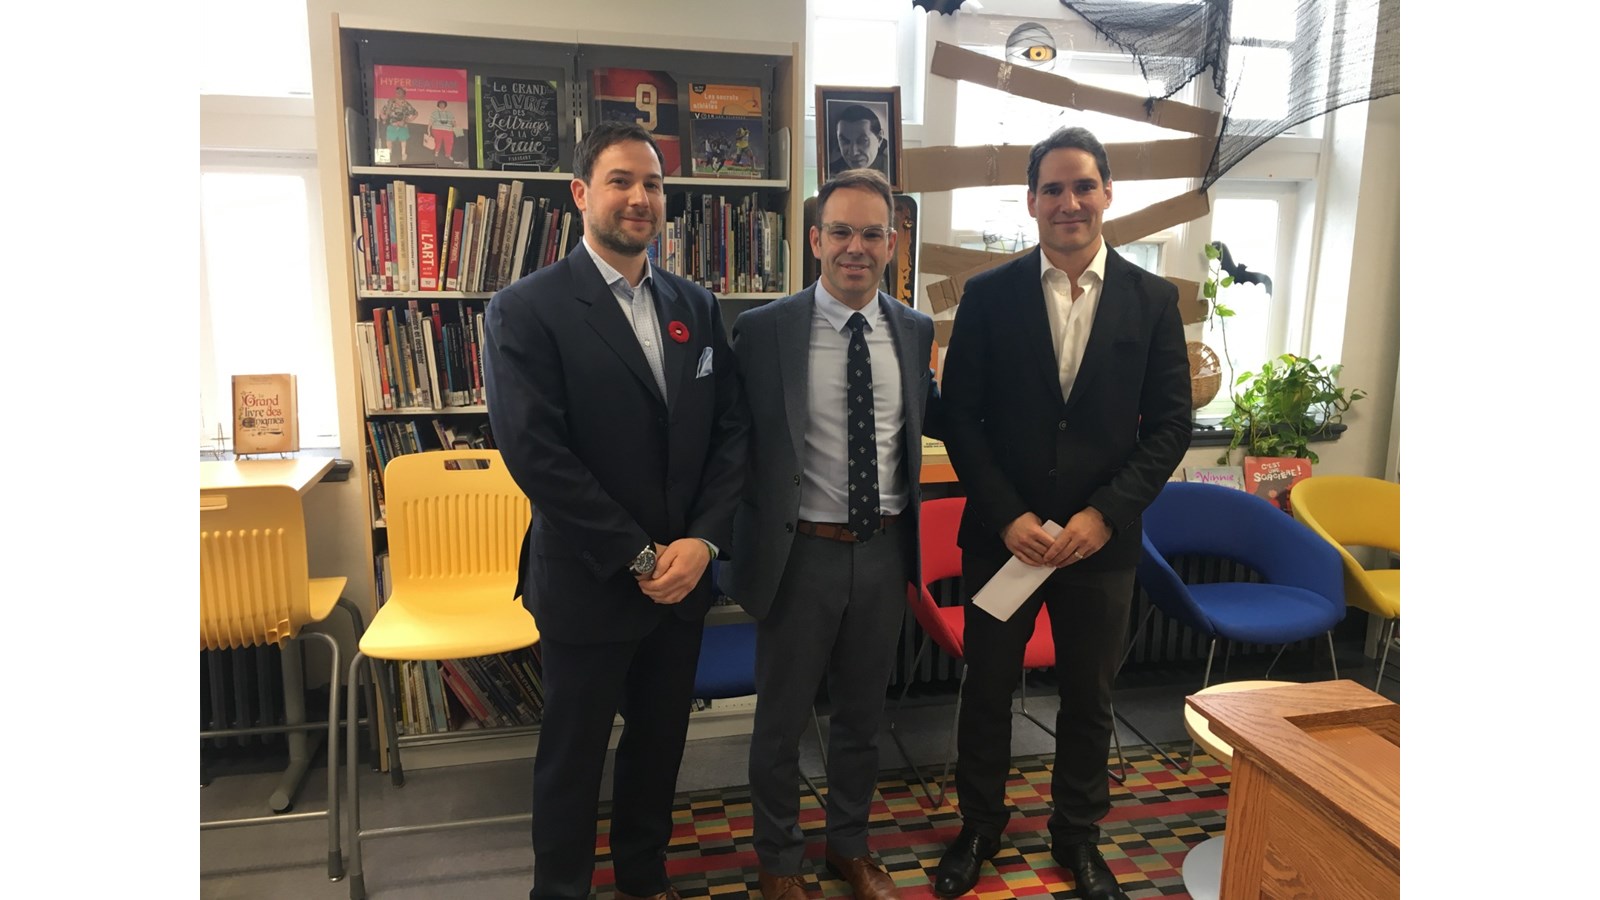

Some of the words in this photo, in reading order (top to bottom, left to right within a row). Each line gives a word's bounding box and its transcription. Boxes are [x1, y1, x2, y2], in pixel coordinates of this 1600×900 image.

[494, 82, 507, 92] Le
[512, 83, 546, 95] GRAND
[490, 94, 548, 115] LIVRE
[636, 83, 658, 131] 9
[494, 130, 546, 153] Craie
[422, 234, 434, 267] L'ART
[244, 394, 278, 406] Grand
[245, 407, 264, 417] livre
[267, 406, 281, 416] des
[1261, 462, 1280, 470] C'EST
[1195, 471, 1234, 483] Winnie
